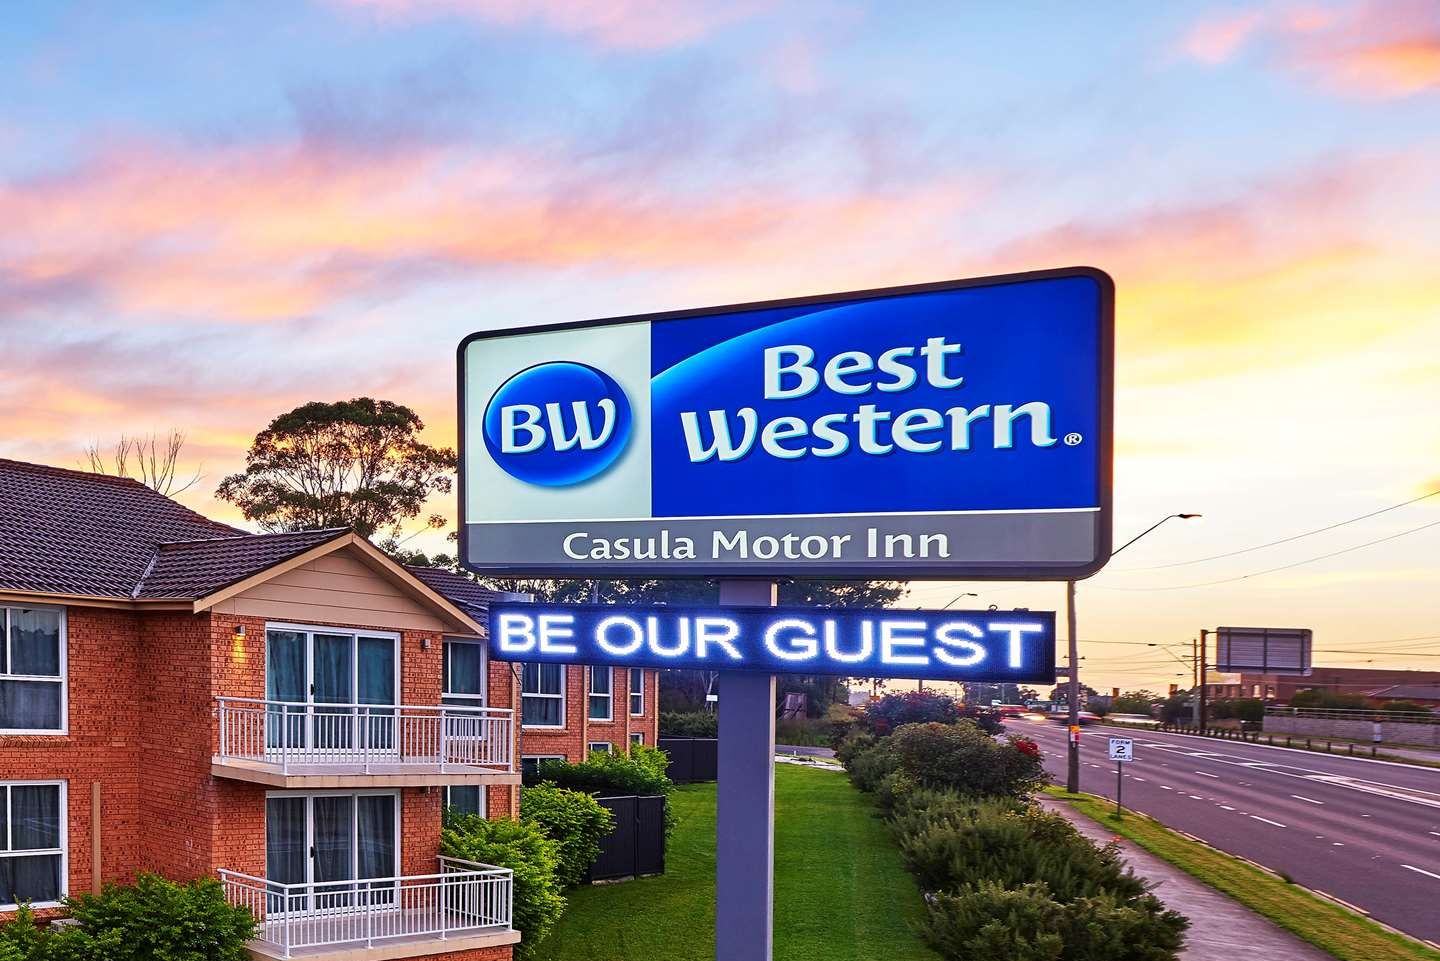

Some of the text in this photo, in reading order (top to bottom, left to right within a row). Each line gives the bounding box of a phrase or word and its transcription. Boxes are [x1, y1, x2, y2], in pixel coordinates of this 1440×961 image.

[764, 336, 964, 399] Best
[501, 398, 616, 454] BW
[563, 527, 951, 560] Casula Motor Inn
[498, 613, 1043, 669] BE OUR GUEST
[1116, 745, 1125, 754] 2
